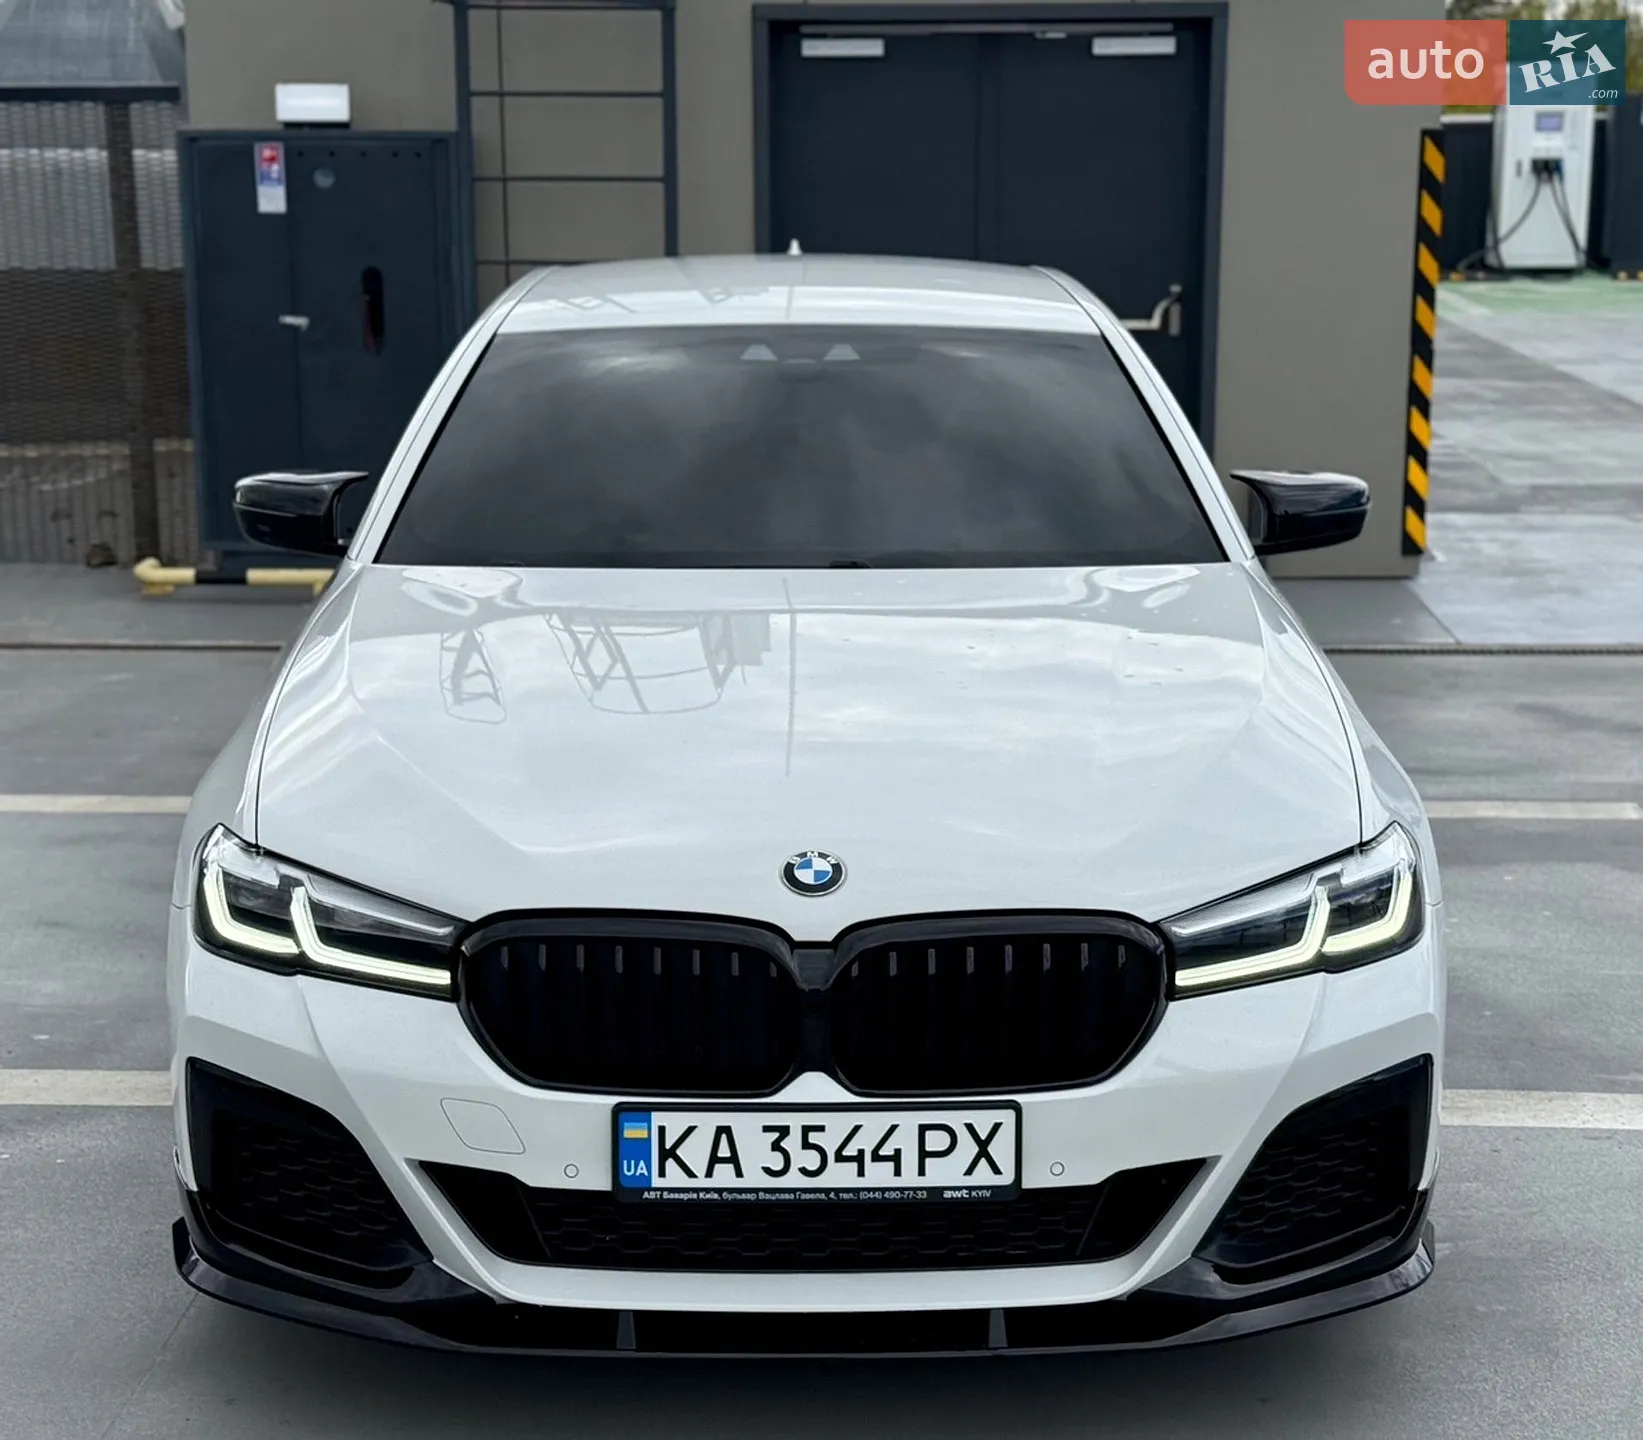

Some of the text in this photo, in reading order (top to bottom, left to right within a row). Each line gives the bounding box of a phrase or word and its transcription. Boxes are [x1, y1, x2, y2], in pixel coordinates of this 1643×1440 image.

[788, 851, 840, 865] BMW
[657, 1121, 1004, 1179] KA 3544 PX
[623, 1159, 649, 1177] UA
[642, 1191, 661, 1200] АВТ
[883, 1190, 928, 1200] 490-77-33
[942, 1189, 993, 1199] awt KYIV
